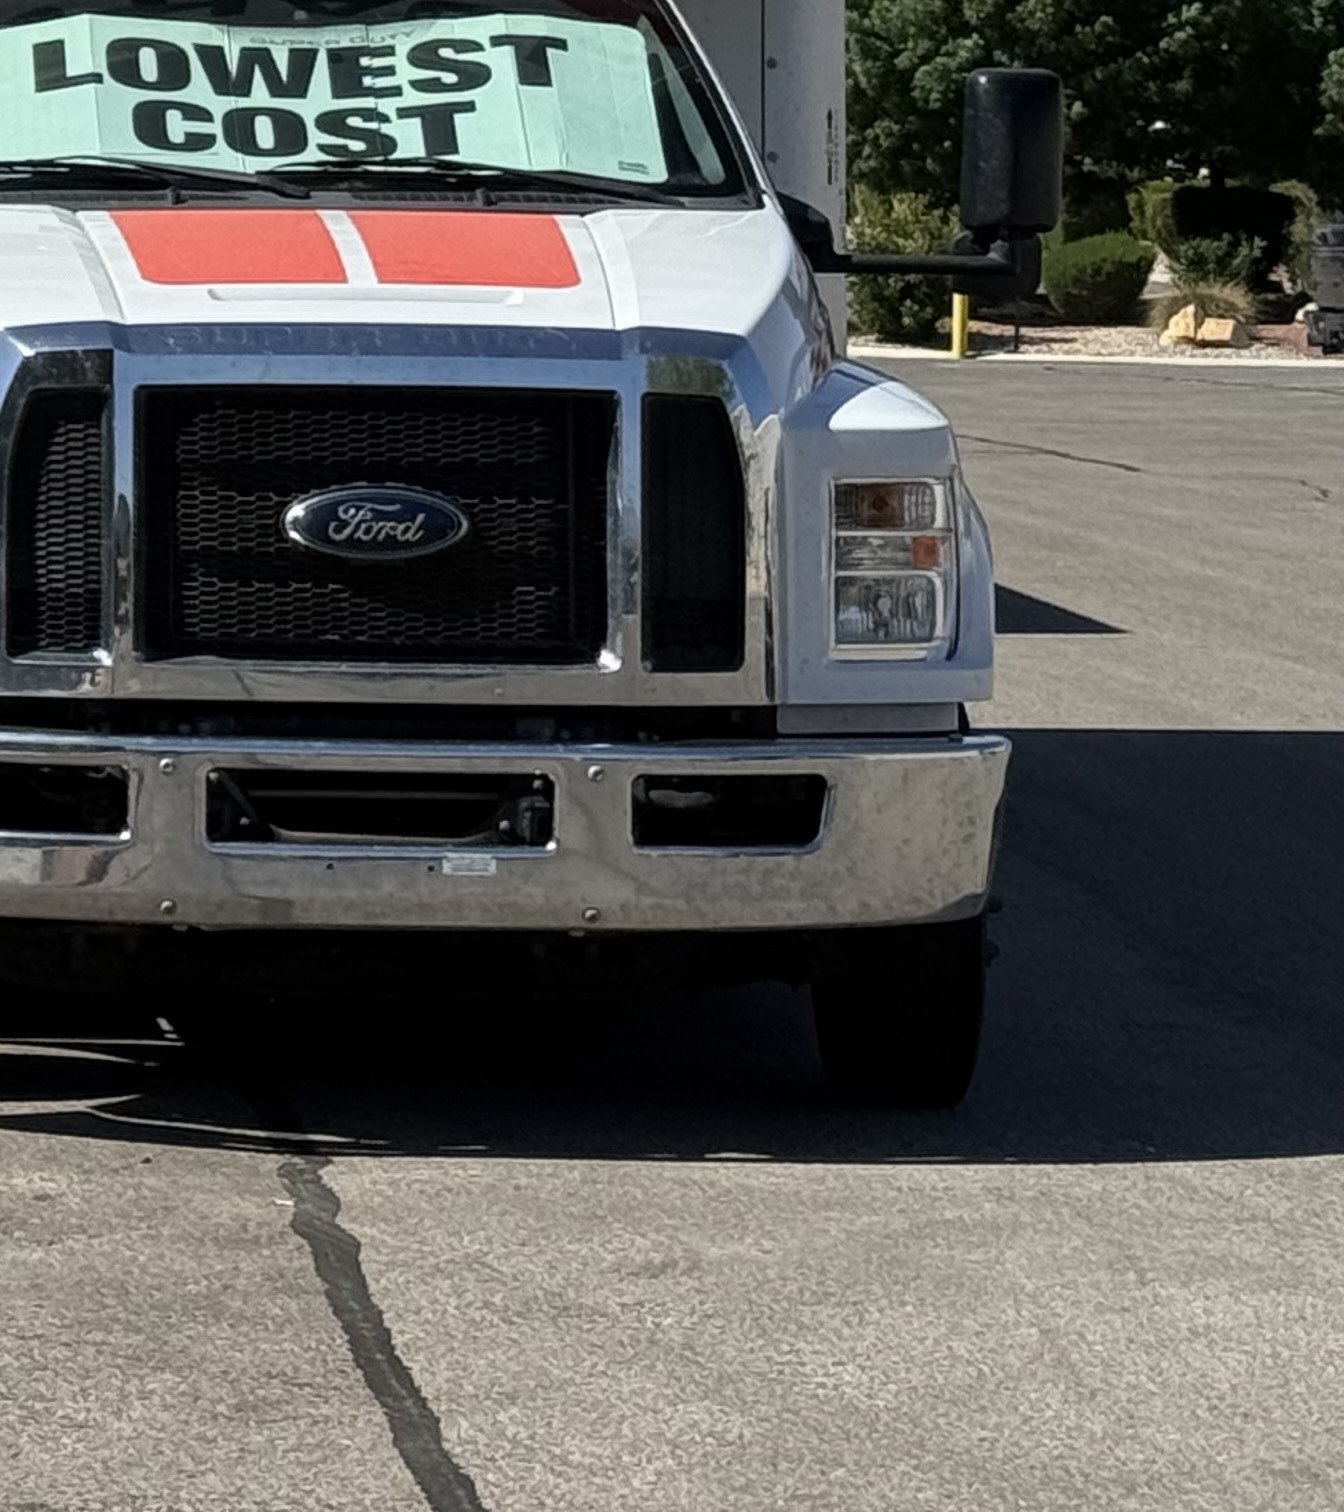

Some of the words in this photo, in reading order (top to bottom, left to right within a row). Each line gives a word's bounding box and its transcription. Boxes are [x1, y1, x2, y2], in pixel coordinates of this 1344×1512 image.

[30, 34, 569, 101] LOWEST
[130, 99, 477, 160] COST
[327, 500, 428, 543] Ford
